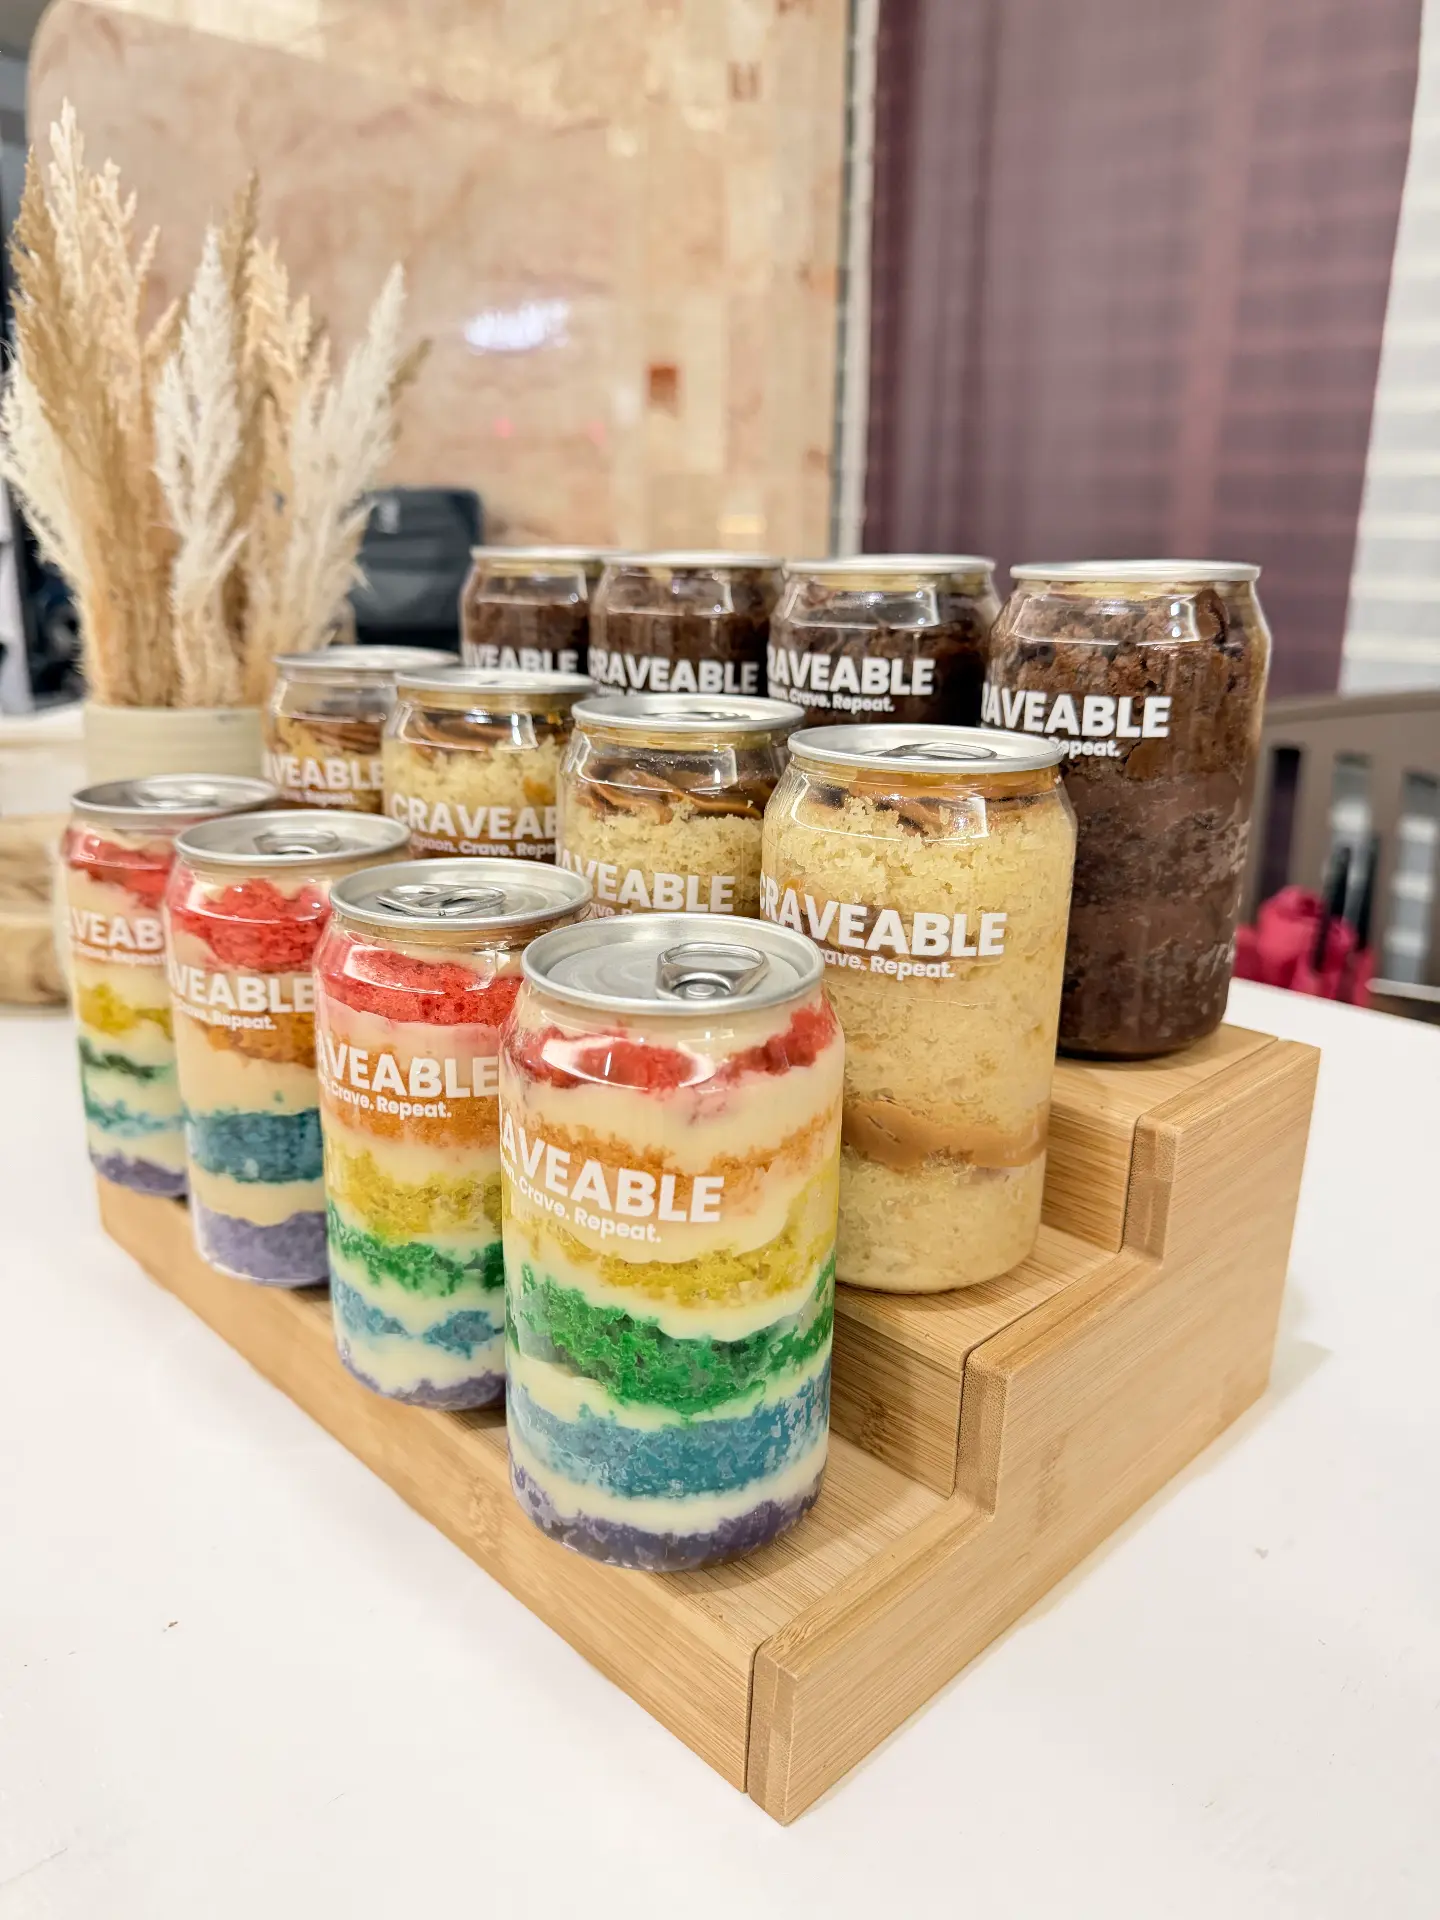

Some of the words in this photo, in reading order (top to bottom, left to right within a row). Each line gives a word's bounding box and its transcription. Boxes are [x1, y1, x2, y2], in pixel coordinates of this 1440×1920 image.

[1048, 737, 1121, 759] epeat.
[821, 950, 867, 971] ave.
[870, 955, 956, 981] Repeat.
[376, 1095, 452, 1120] Repeat.
[519, 1176, 570, 1221] Crave.
[574, 1206, 662, 1243] Repeat.
